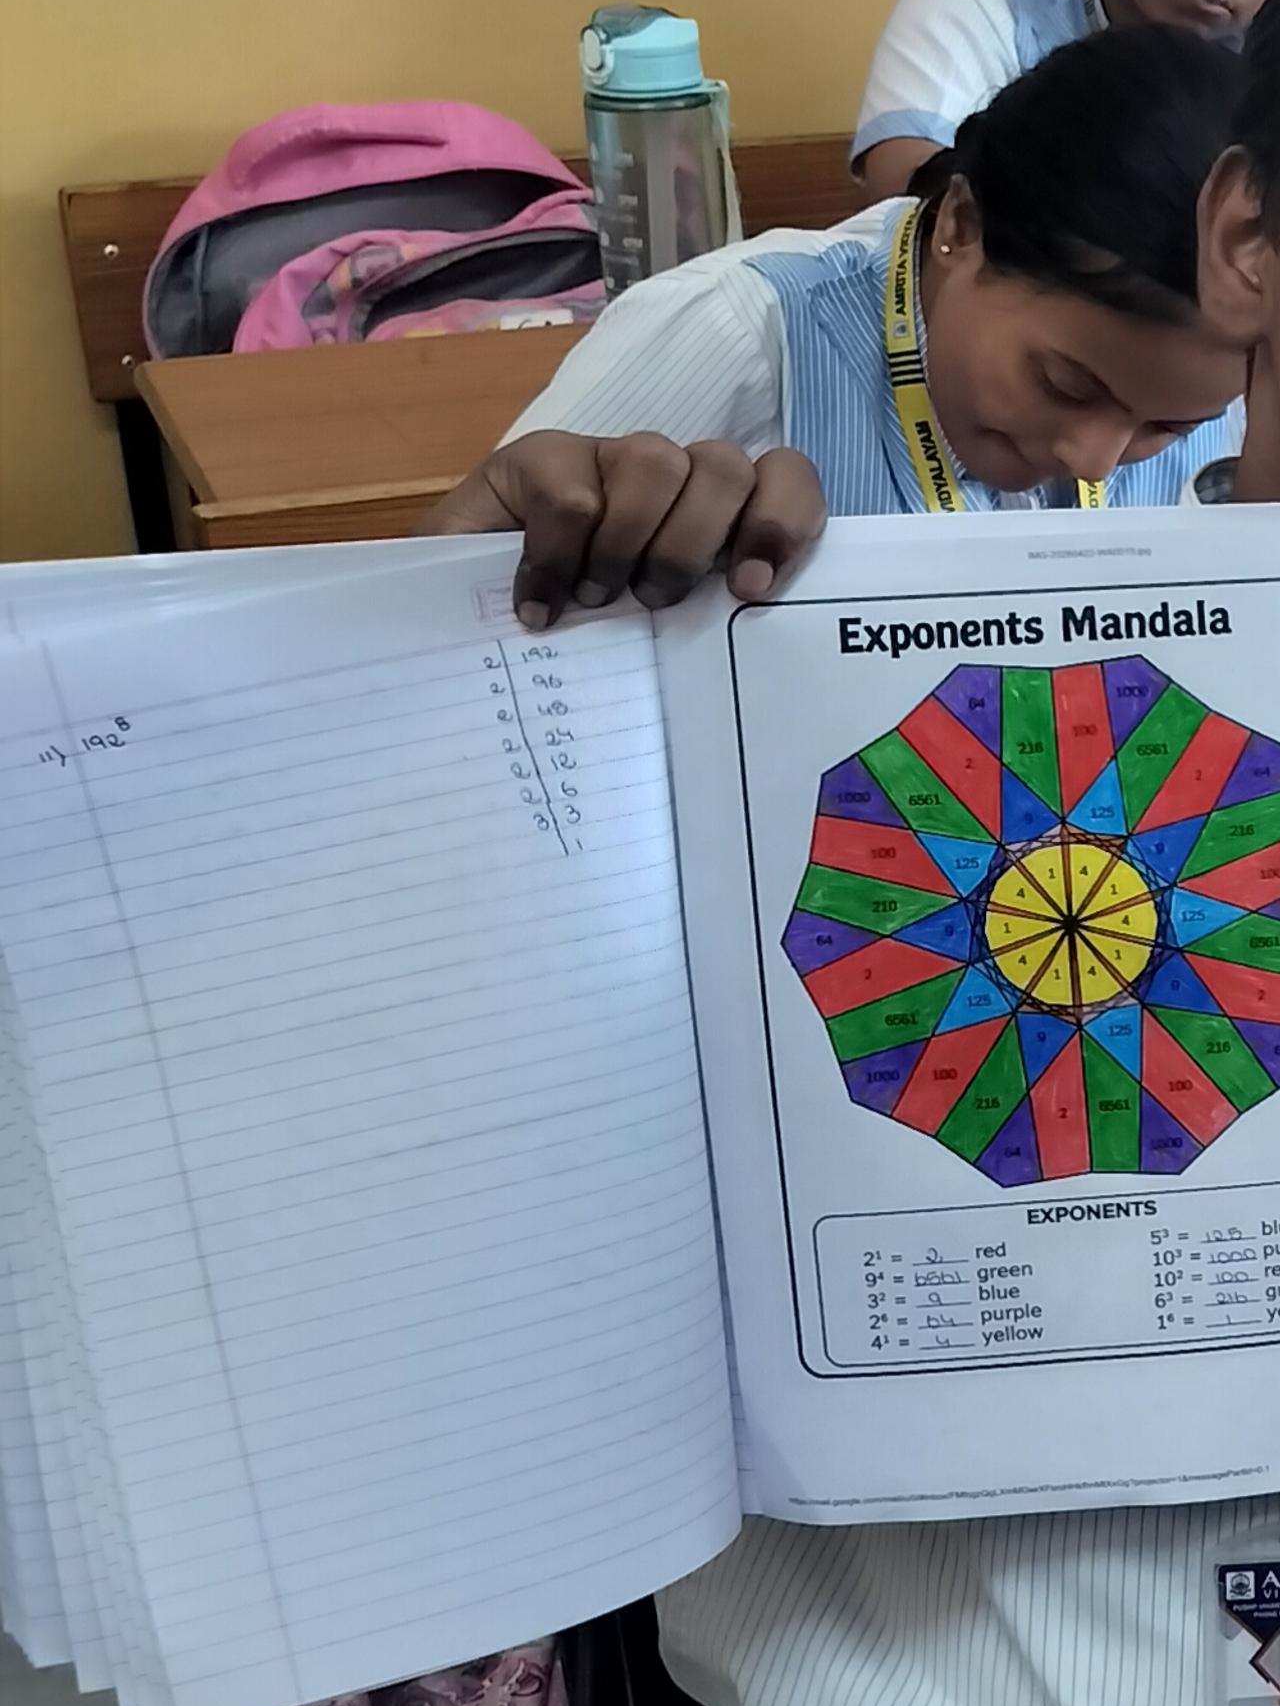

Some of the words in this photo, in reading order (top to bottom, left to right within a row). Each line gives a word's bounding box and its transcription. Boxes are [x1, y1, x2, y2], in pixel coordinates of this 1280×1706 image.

[838, 610, 1044, 658] Exponents
[1061, 599, 1233, 643] Mandala
[521, 645, 558, 663] 192
[483, 656, 501, 671] 2
[545, 728, 575, 746] 24
[1136, 743, 1169, 756] 6561
[551, 752, 577, 771] 12
[909, 794, 941, 806] 6561
[566, 804, 582, 824] 3
[1090, 805, 1114, 819] 125
[955, 858, 979, 870] 125
[1181, 909, 1206, 923] 125
[967, 995, 991, 1008] 125
[885, 1013, 917, 1026] 6561
[1026, 1199, 1158, 1225] EXPONENTS
[975, 1242, 1007, 1259] red
[977, 1263, 1033, 1283] green
[978, 1285, 1021, 1301] blue
[980, 1304, 1043, 1325] purple
[981, 1326, 1044, 1347] yellow
